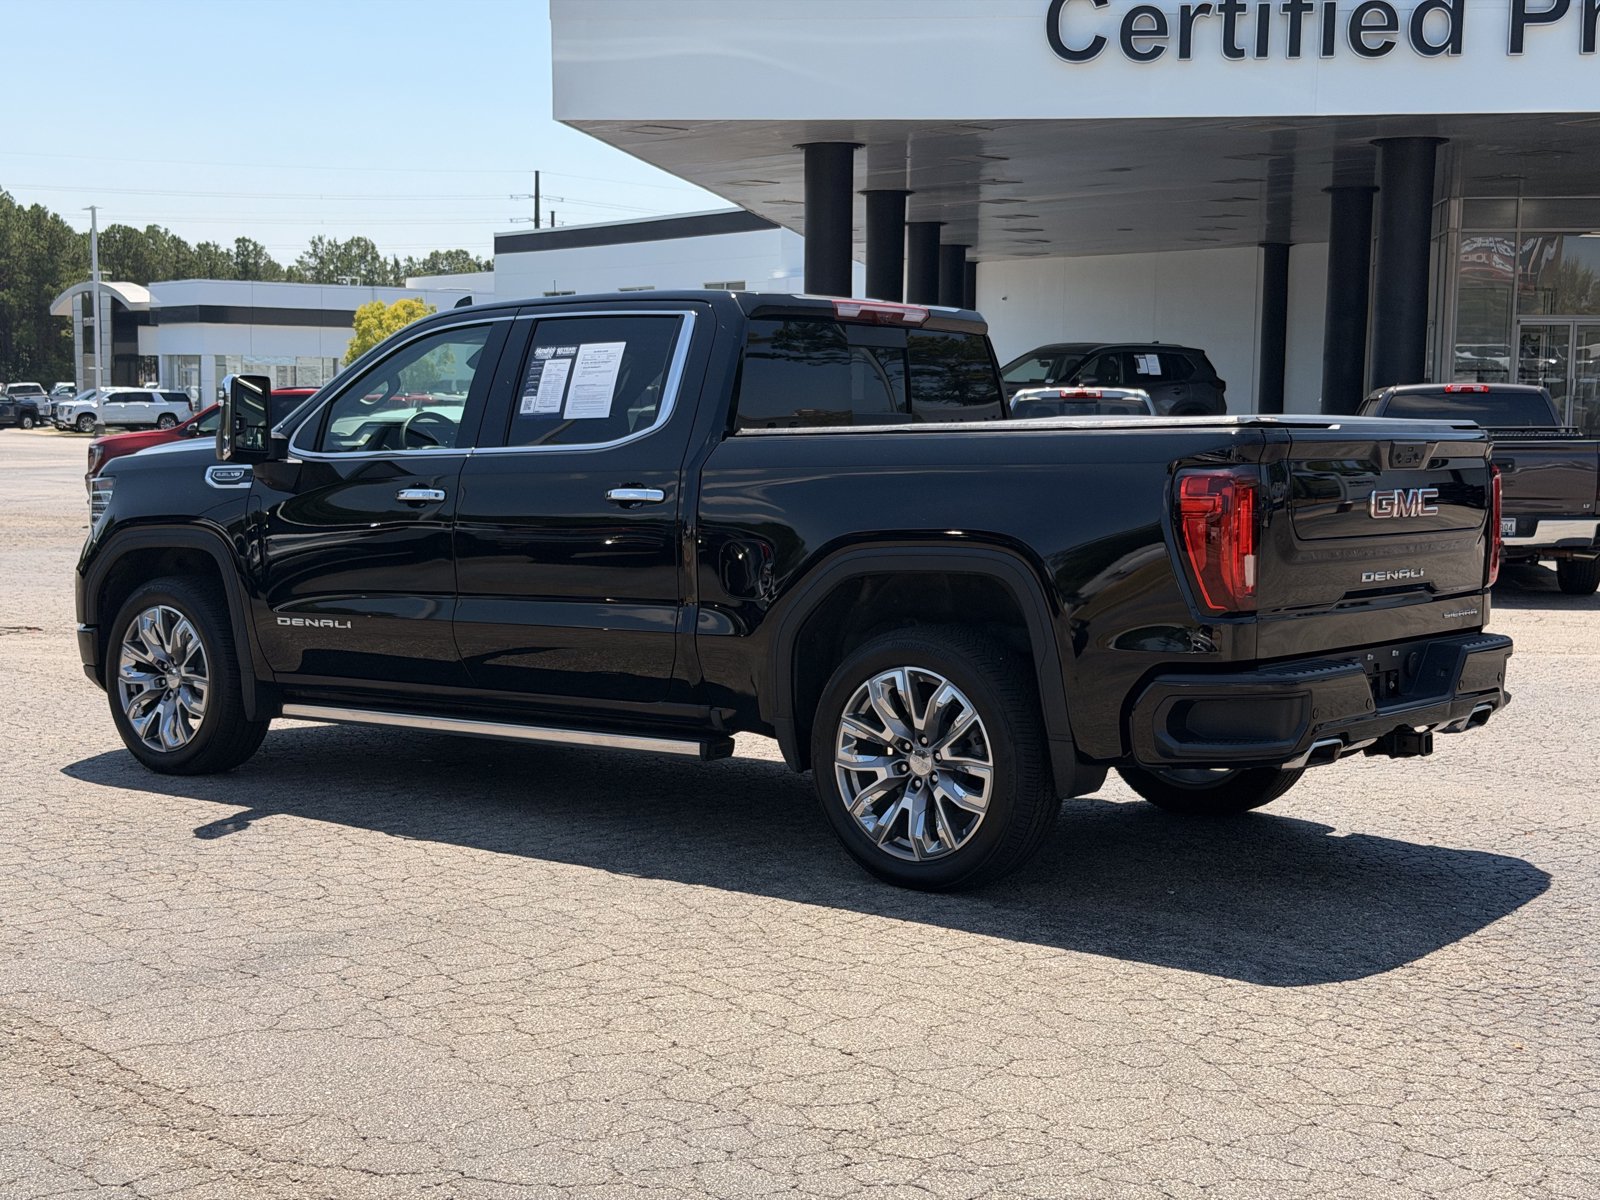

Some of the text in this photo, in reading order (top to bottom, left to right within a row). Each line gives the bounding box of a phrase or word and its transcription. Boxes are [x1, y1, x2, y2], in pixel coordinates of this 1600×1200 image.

[1045, 0, 1465, 64] Certified
[1370, 488, 1439, 519] GMC
[1361, 568, 1425, 583] DENALI
[276, 617, 352, 629] DENALI
